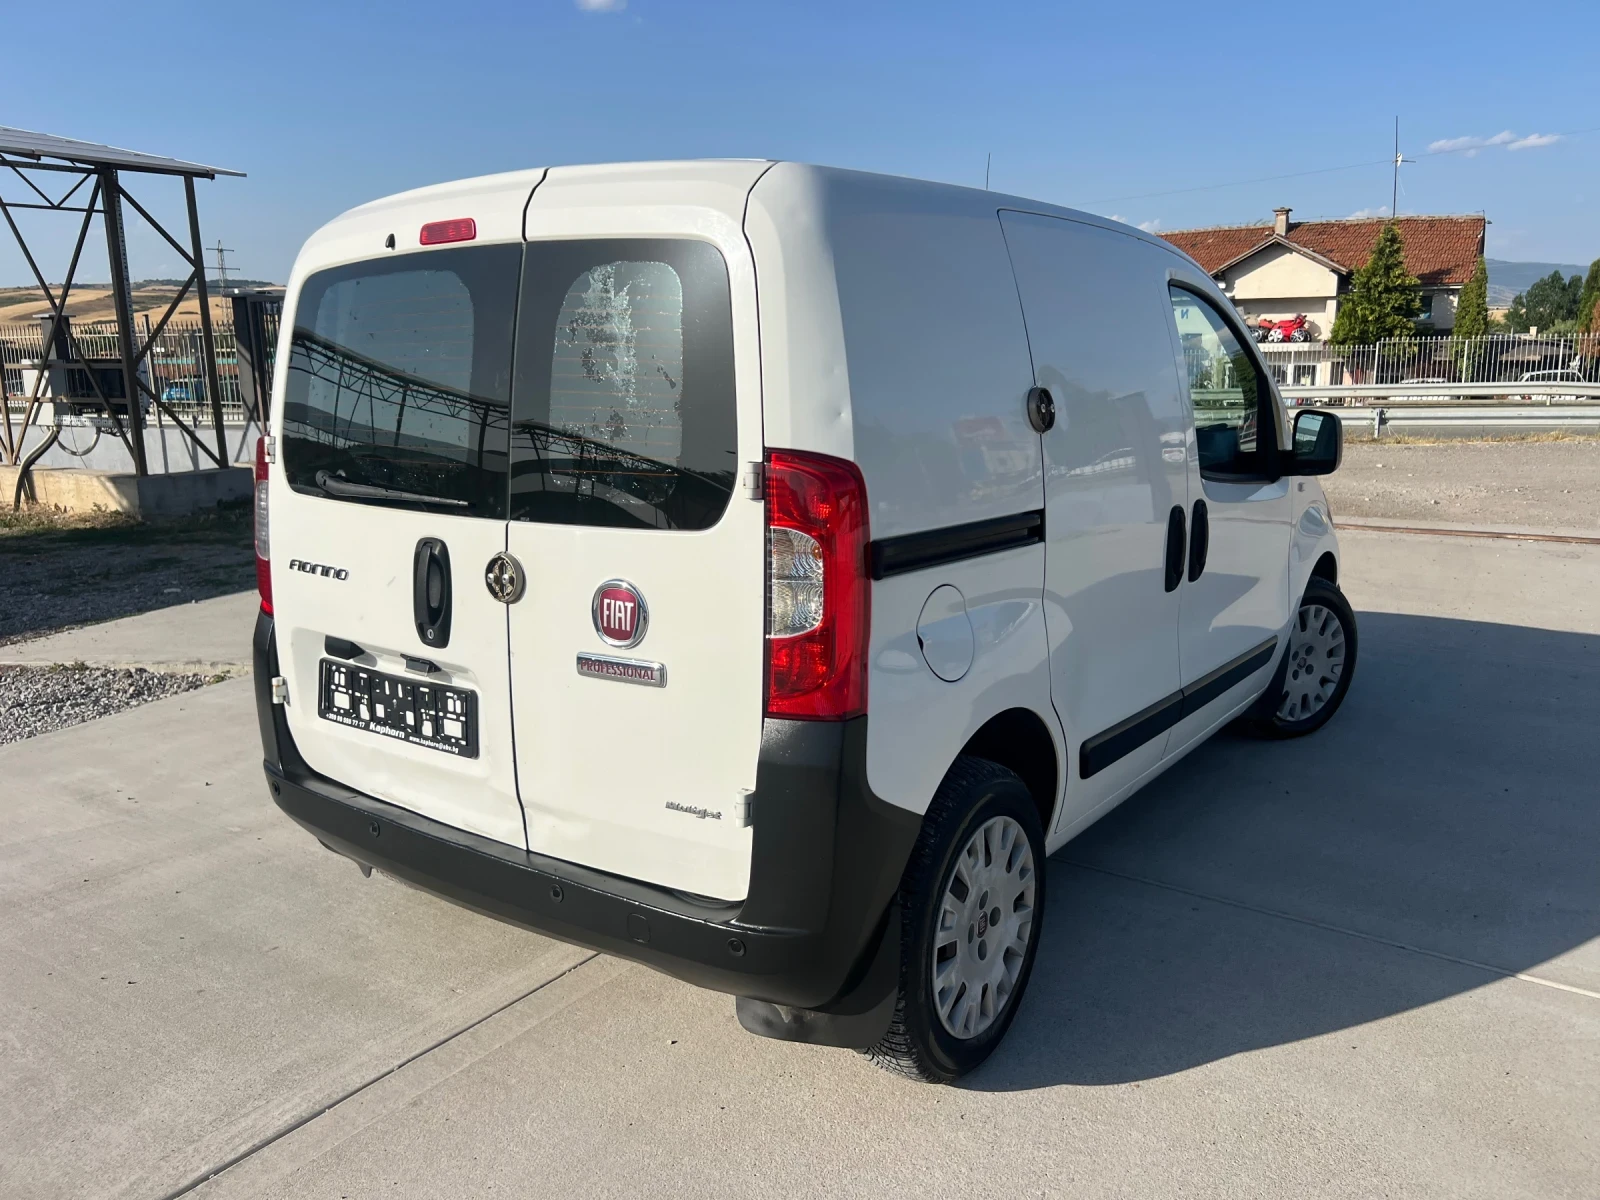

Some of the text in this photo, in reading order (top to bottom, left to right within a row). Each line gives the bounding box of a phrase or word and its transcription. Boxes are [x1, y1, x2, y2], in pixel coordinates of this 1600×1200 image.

[603, 598, 634, 631] FIAT
[580, 660, 656, 680] PROFESSIONAL
[369, 721, 405, 739] Kaphorn
